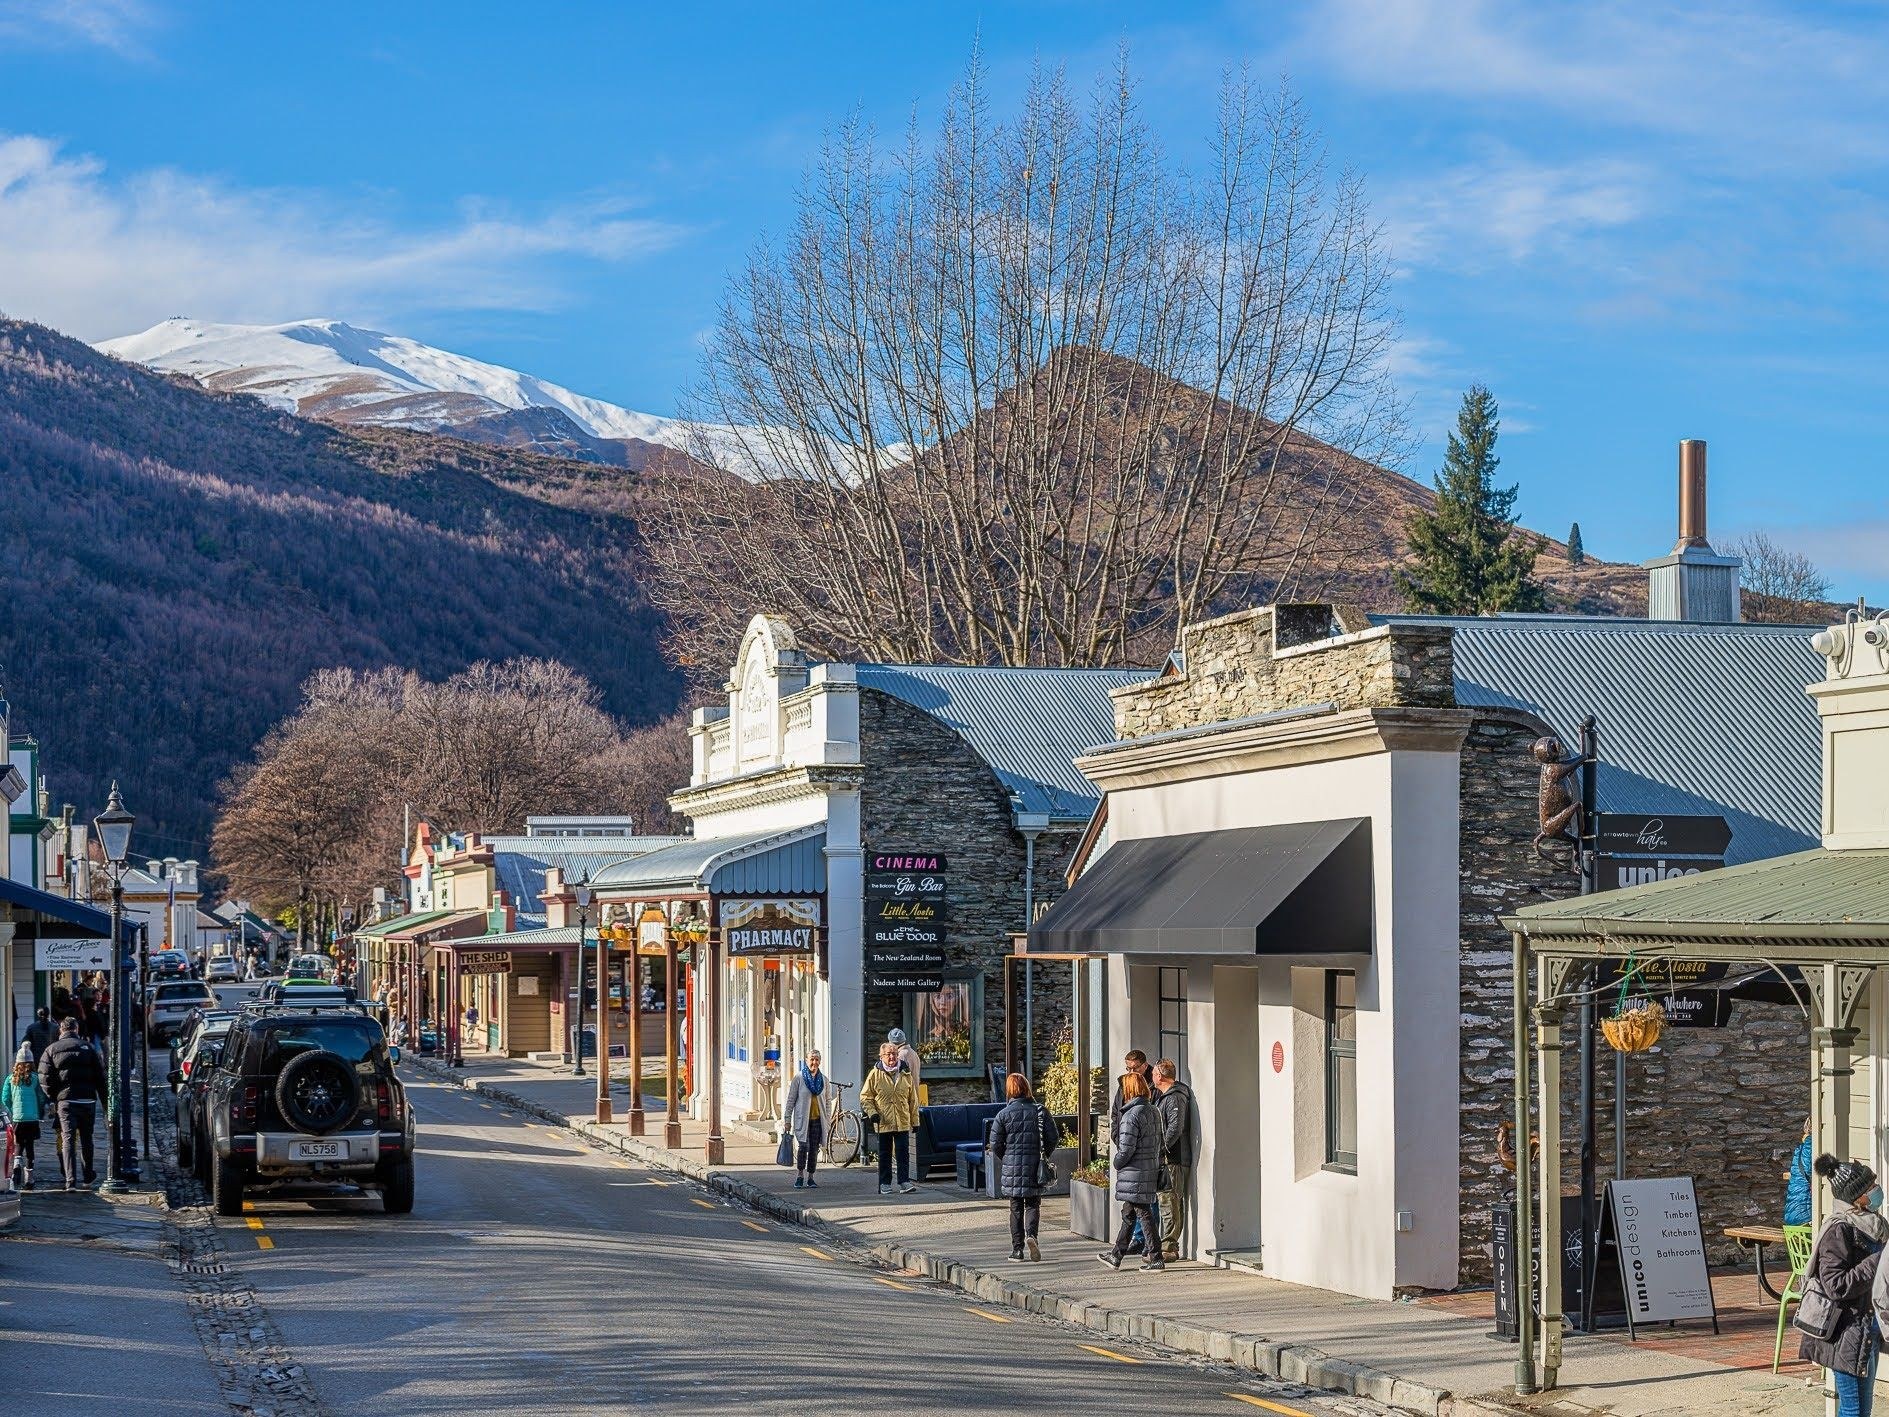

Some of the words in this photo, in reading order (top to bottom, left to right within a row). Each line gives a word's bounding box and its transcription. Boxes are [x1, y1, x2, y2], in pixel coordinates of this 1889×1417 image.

[1636, 818, 1663, 850] hair
[875, 857, 938, 869] CINEMA
[895, 877, 917, 896] Gin
[918, 877, 944, 891] Bar
[879, 901, 908, 916] Little
[907, 902, 935, 916] Aosta
[731, 928, 811, 952] PHARMACY
[46, 943, 72, 954] Golden
[461, 953, 480, 963] THE
[481, 951, 509, 962] SHED
[917, 979, 941, 988] Gallery
[301, 1144, 336, 1155] NLS758
[1670, 1192, 1689, 1201] Tiles
[1664, 1210, 1693, 1219] Timber
[1621, 1194, 1641, 1256] design
[1661, 1229, 1697, 1238] Kitchens
[1656, 1248, 1701, 1258] Bathrooms
[1498, 1245, 1507, 1312] OPEN
[1633, 1260, 1650, 1312] unico
